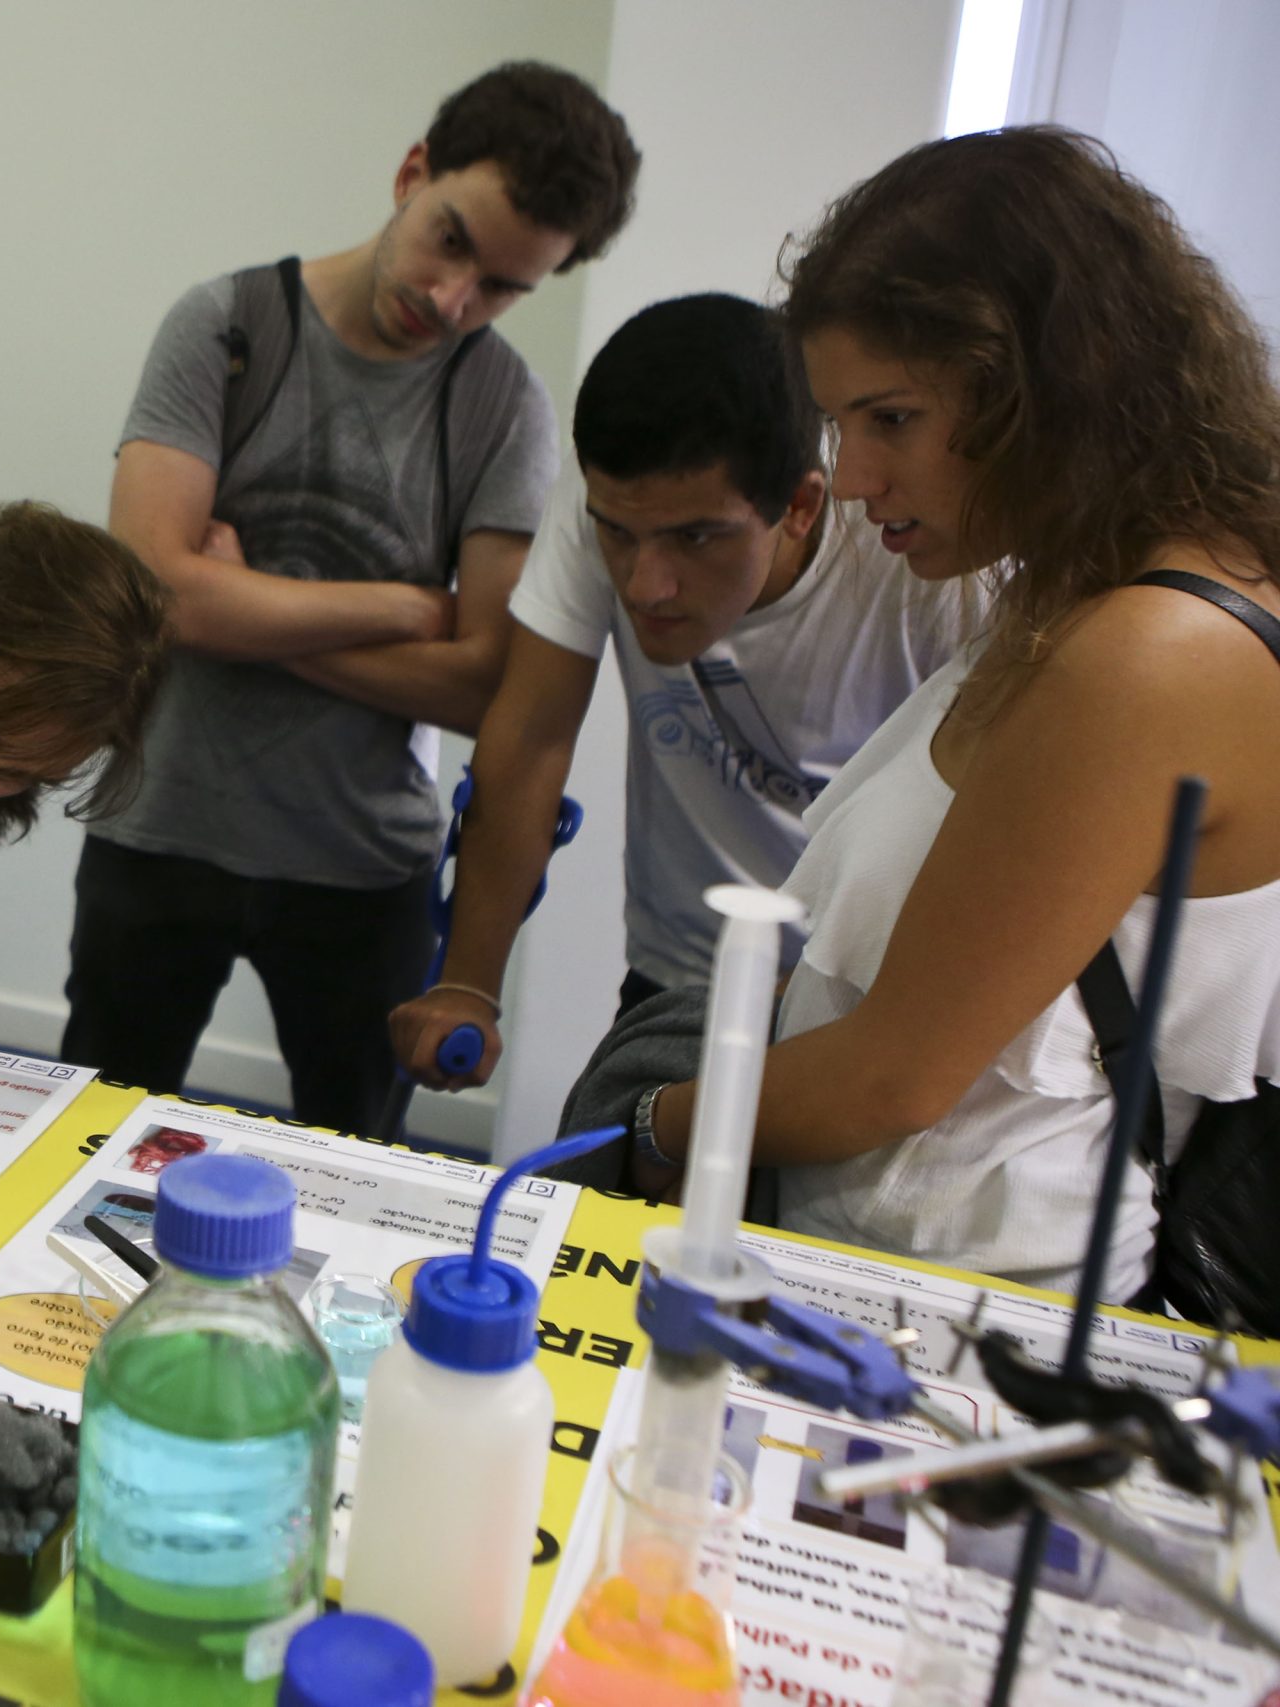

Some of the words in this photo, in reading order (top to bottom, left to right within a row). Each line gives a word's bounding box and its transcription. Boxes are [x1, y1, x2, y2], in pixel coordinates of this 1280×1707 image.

[378, 1207, 432, 1225] redução:
[434, 1220, 450, 1229] de
[368, 1217, 426, 1235] oxidação:
[429, 1231, 444, 1240] de
[30, 1297, 74, 1315] cobre
[6, 1323, 44, 1341] ferro
[48, 1335, 69, 1348] de
[732, 1618, 810, 1657] Palh
